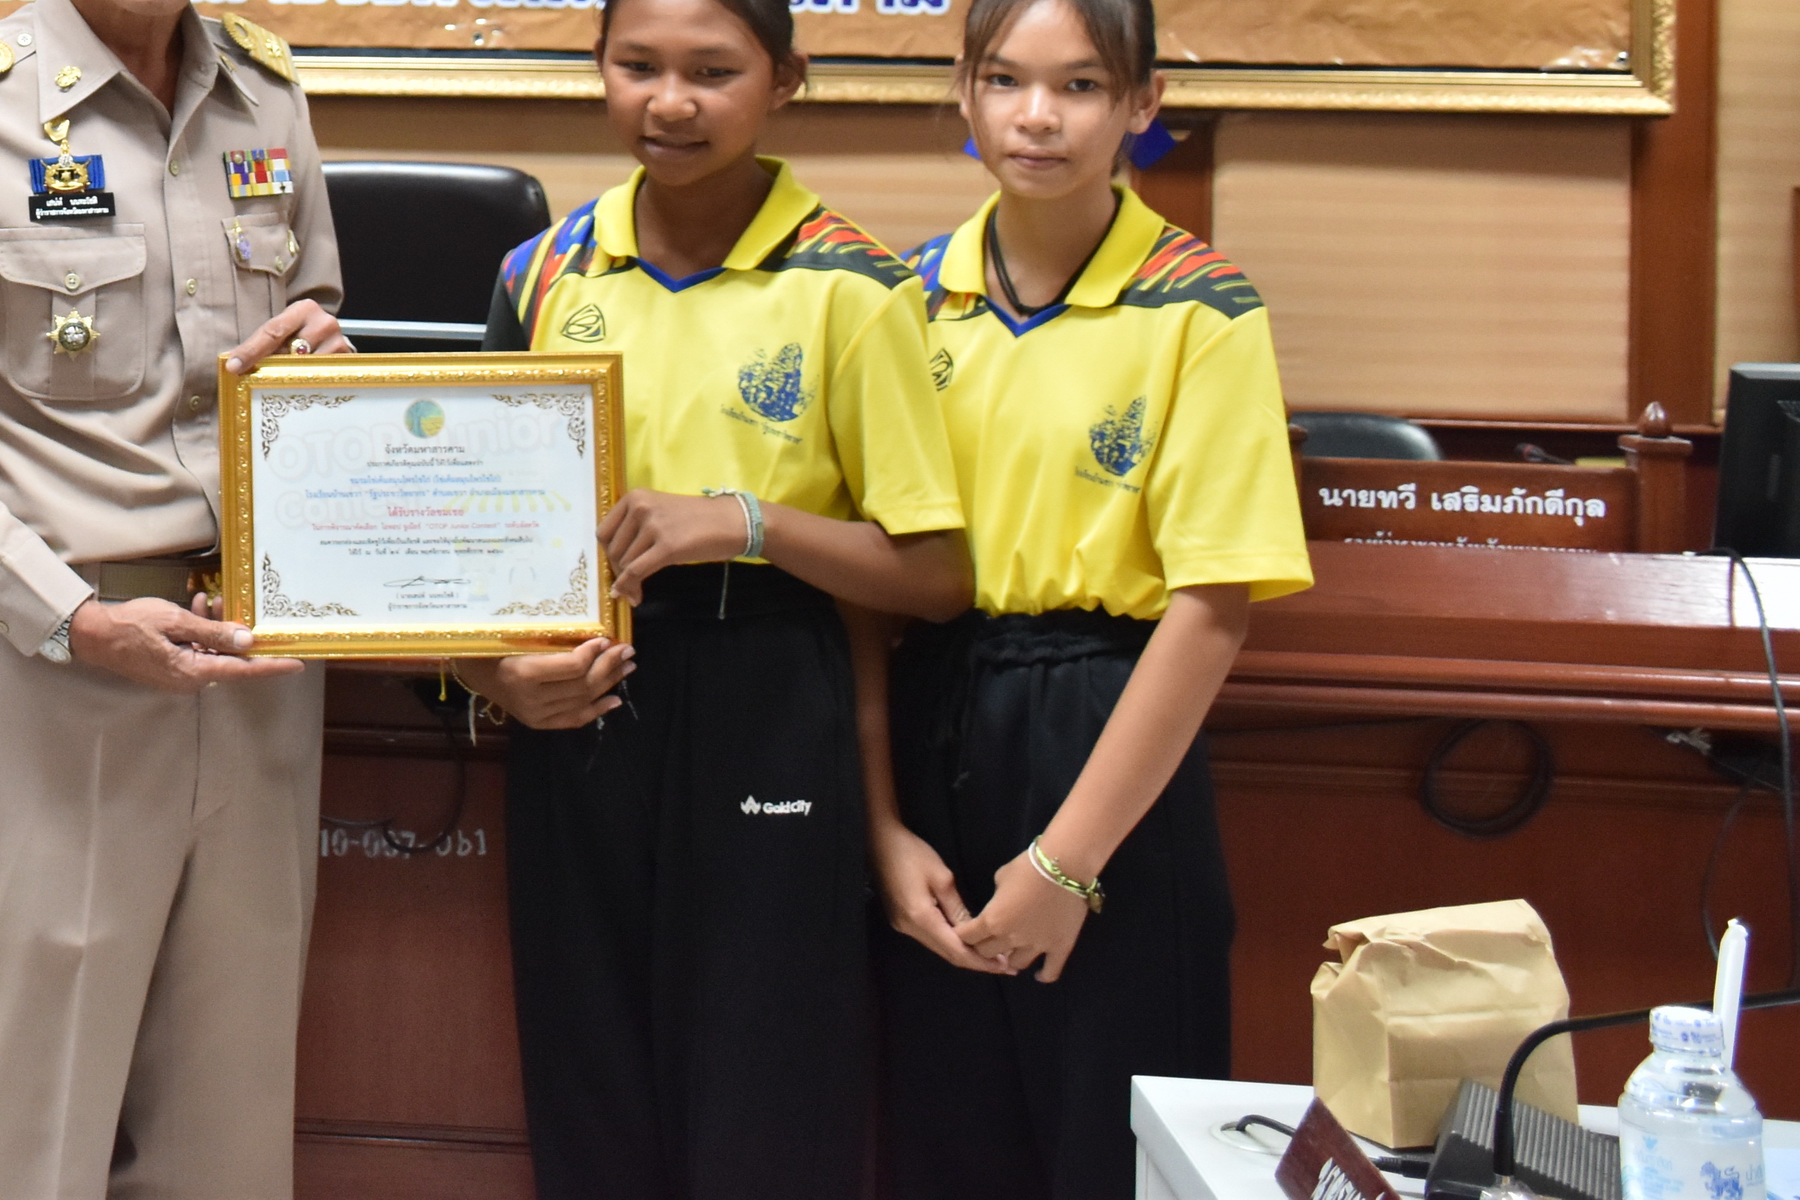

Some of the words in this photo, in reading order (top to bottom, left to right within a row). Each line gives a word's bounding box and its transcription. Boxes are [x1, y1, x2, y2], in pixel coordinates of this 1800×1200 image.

[1319, 482, 1417, 510] นายทวี
[1430, 484, 1606, 527] เสริมภักดีกุล
